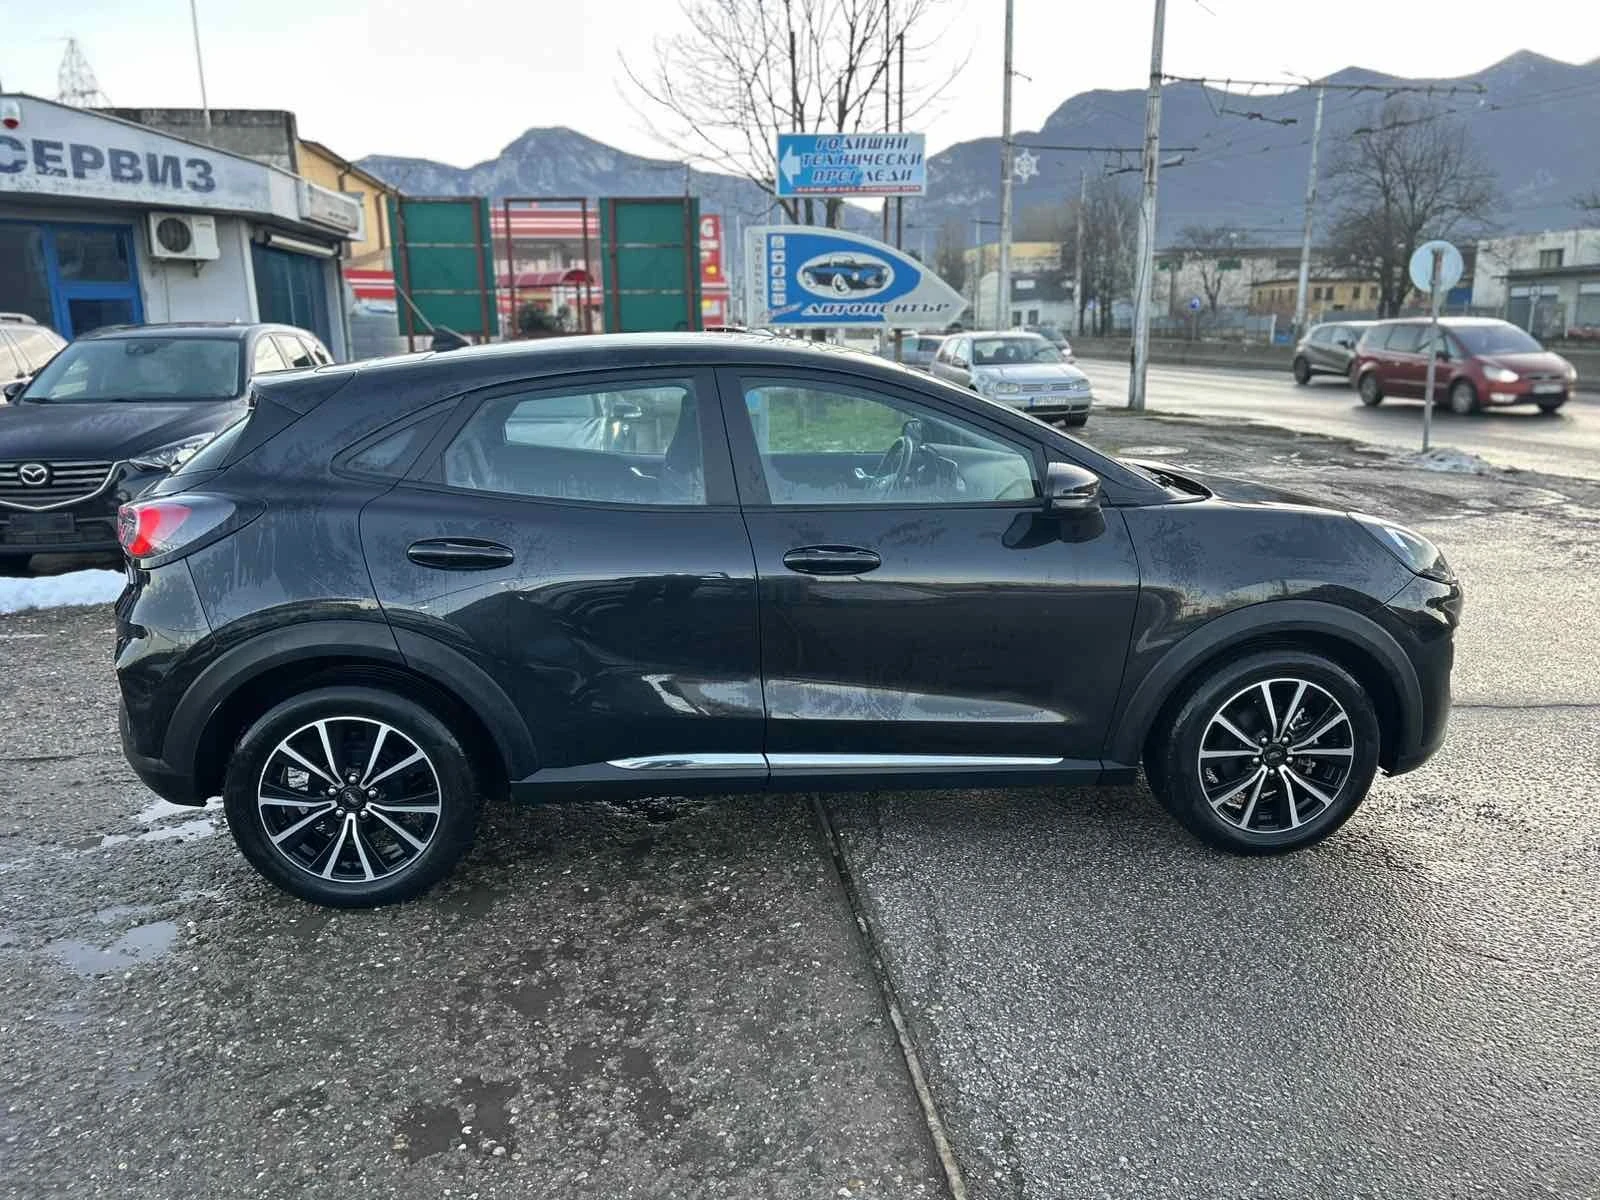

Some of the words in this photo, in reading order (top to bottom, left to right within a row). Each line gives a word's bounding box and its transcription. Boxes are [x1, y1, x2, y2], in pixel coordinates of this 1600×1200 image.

[816, 137, 909, 150] ГОДИШНИ
[0, 135, 216, 193] СЕРВИЗ
[802, 153, 921, 166] ТЕХНИЧЕСКИ
